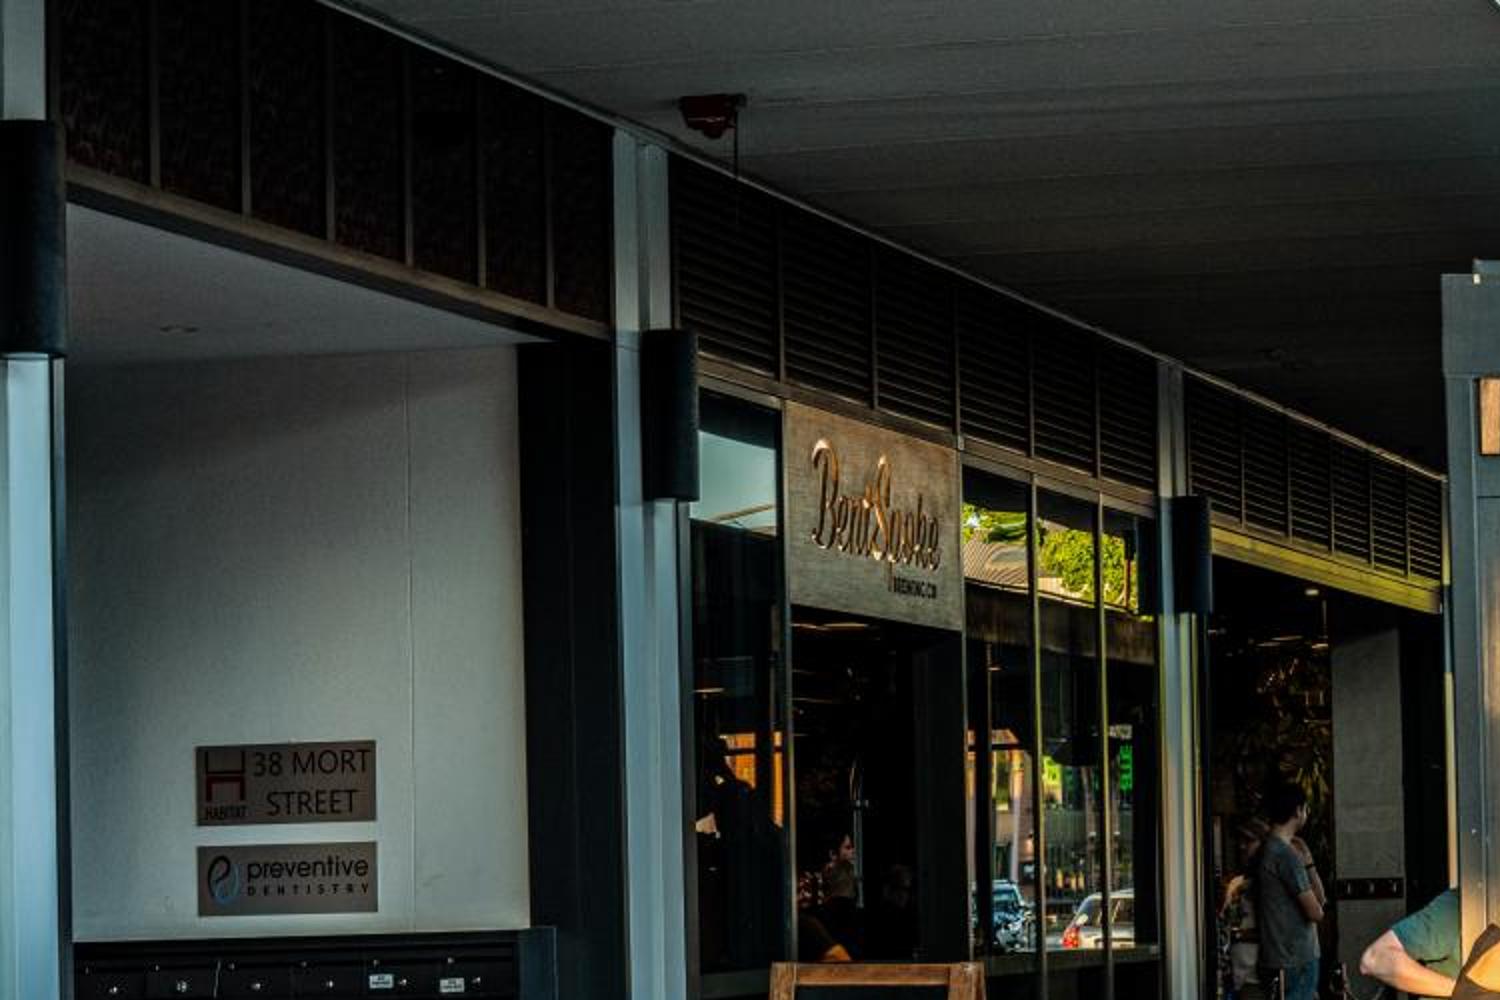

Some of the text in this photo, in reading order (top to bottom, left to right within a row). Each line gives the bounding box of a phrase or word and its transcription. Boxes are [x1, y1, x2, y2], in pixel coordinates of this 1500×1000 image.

[811, 439, 941, 592] BentSpoke
[252, 748, 373, 778] 38 MORT
[265, 788, 359, 817] STREET
[247, 855, 369, 883] preventive
[247, 884, 369, 897] DENTISTRY
